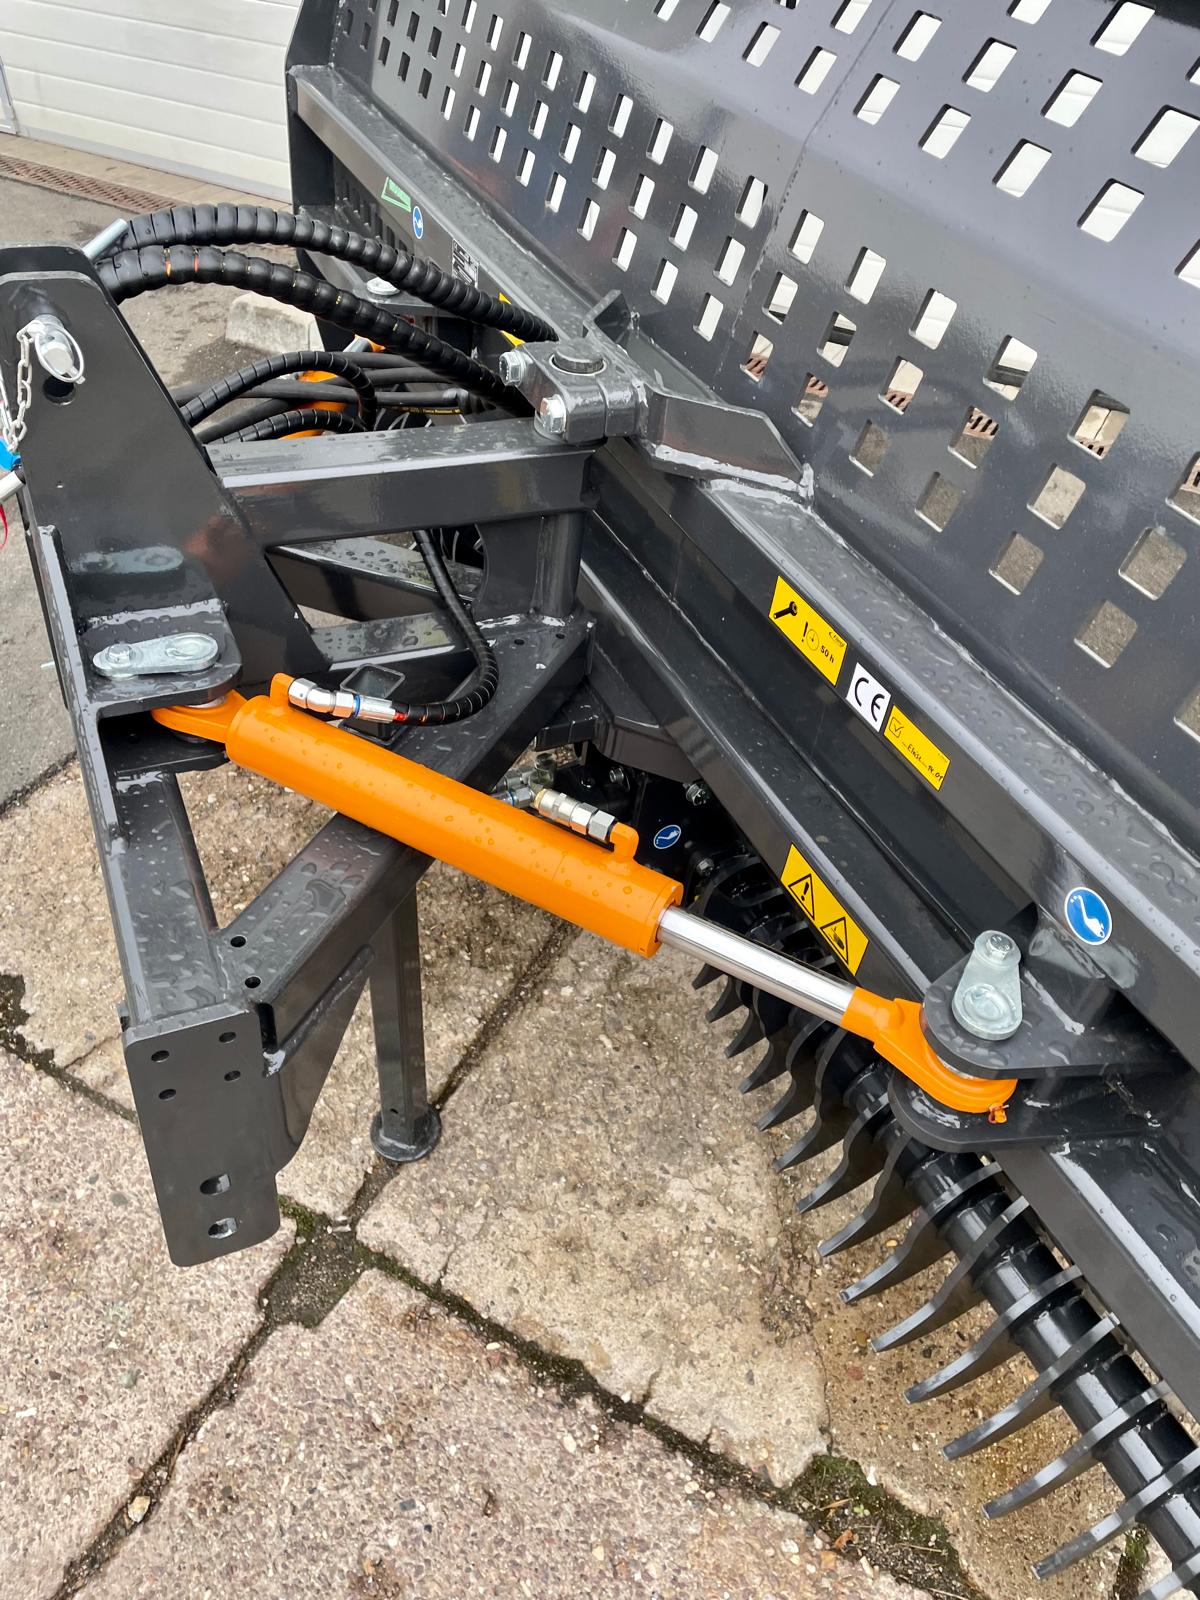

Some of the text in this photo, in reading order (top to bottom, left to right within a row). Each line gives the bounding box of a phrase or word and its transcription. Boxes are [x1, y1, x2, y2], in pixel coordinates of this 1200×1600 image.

[820, 645, 835, 664] 50 h
[854, 676, 885, 722] CE
